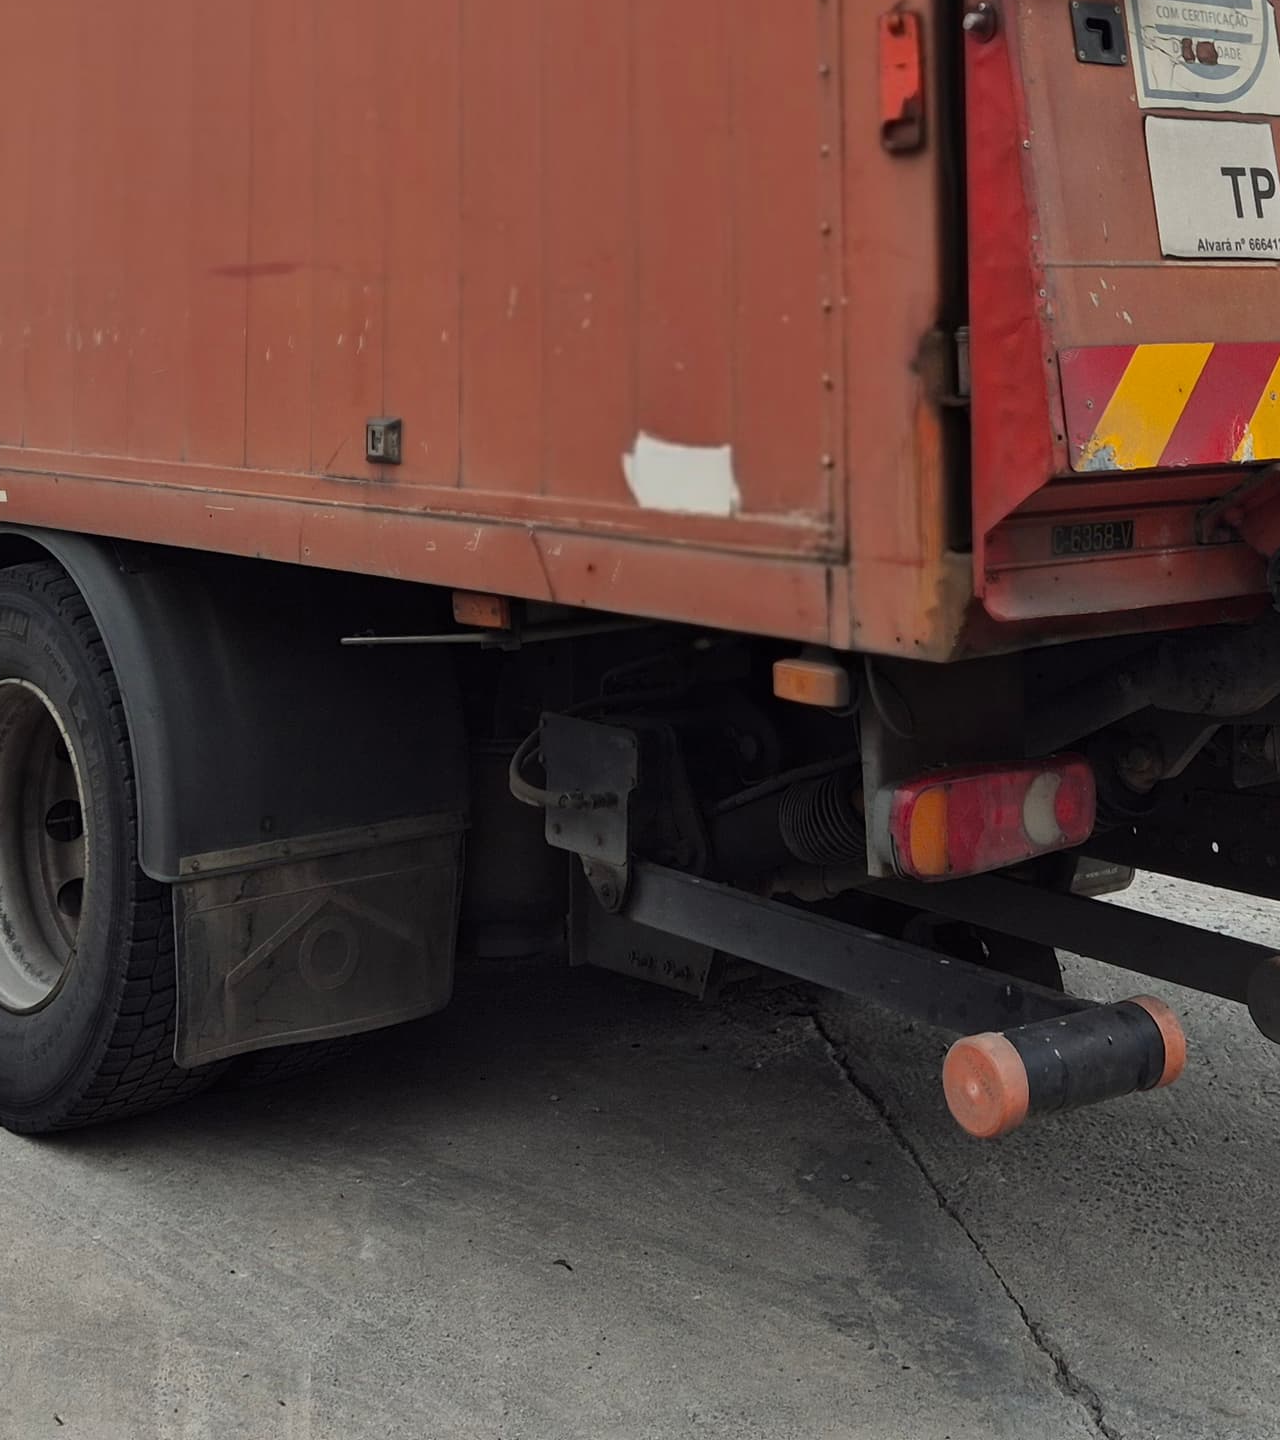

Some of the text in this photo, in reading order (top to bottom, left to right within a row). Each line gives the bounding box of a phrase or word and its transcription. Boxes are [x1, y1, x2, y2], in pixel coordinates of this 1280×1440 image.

[1155, 5, 1249, 29] COM CERTIFICAÇÃO
[1220, 167, 1276, 218] TP
[1197, 238, 1232, 252] Alvará
